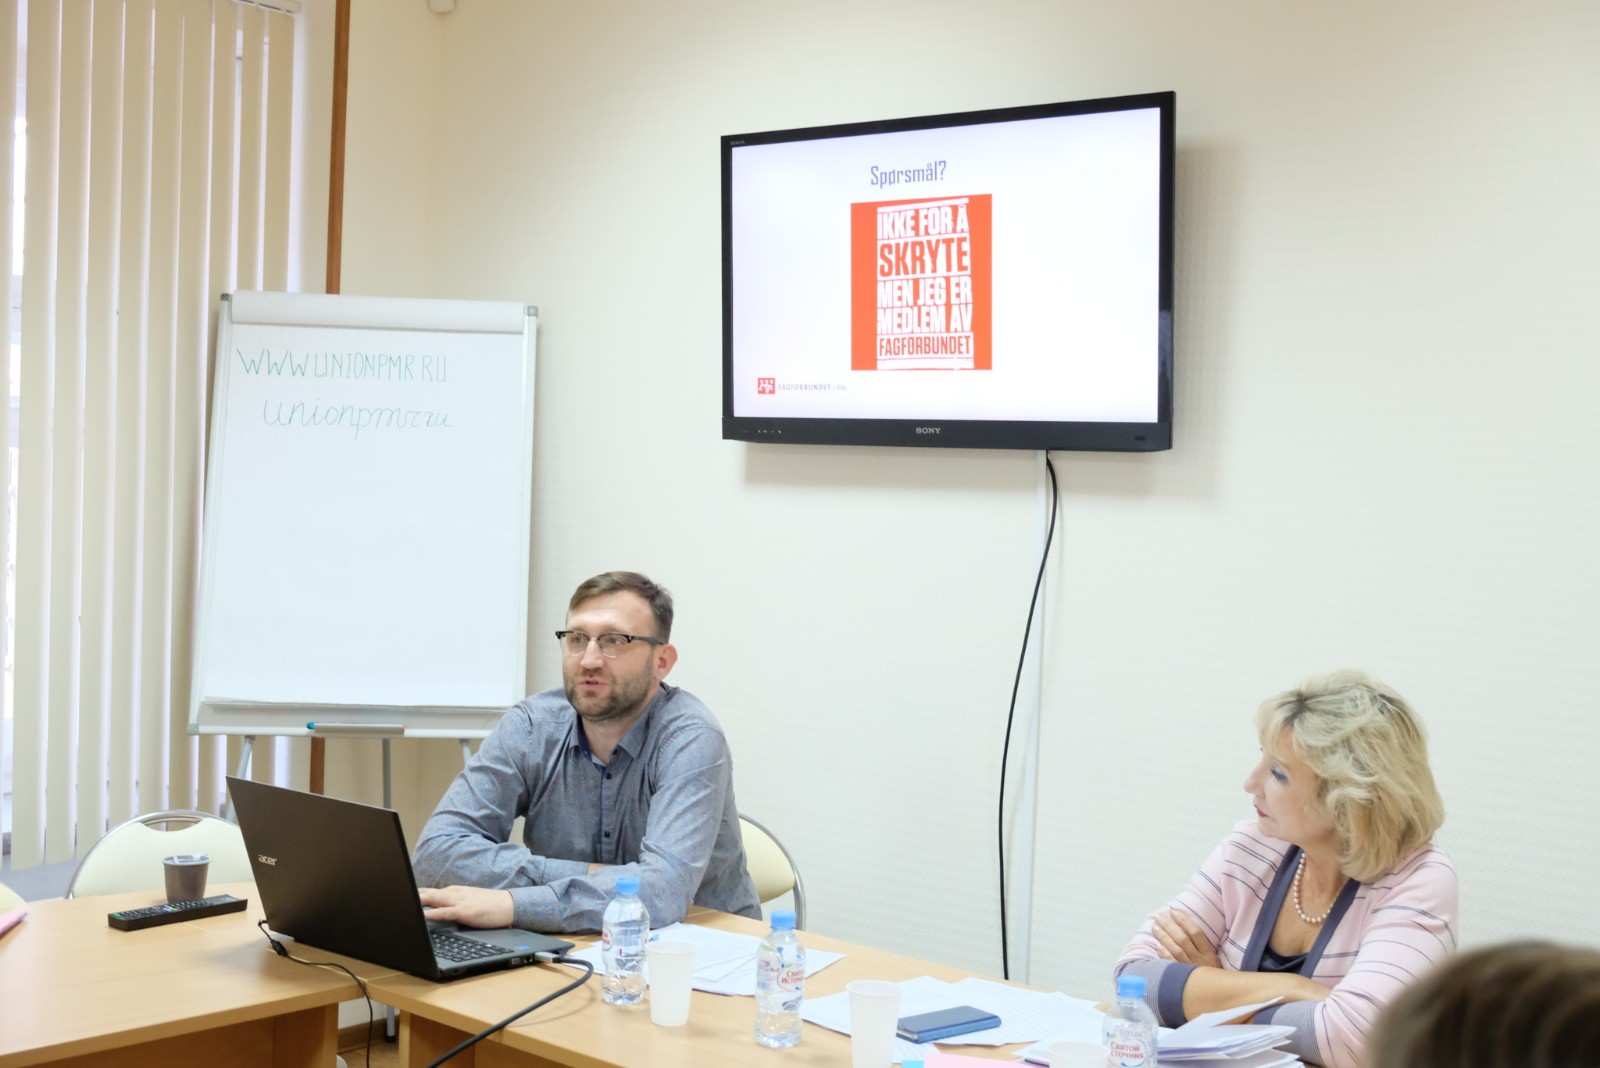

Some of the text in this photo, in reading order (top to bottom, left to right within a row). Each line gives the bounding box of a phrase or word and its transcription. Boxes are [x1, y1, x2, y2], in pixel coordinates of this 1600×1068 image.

[870, 160, 947, 189] Spørsmål?
[877, 203, 969, 240] IKKE FOR Å
[879, 236, 969, 277] SKRYTE
[877, 276, 972, 308] MEN JEG ER
[877, 304, 973, 335] MEDLEM AV
[879, 336, 971, 357] FAGFORBUNDET
[778, 383, 831, 391] FAGFORBUNDET
[258, 854, 277, 866] acer
